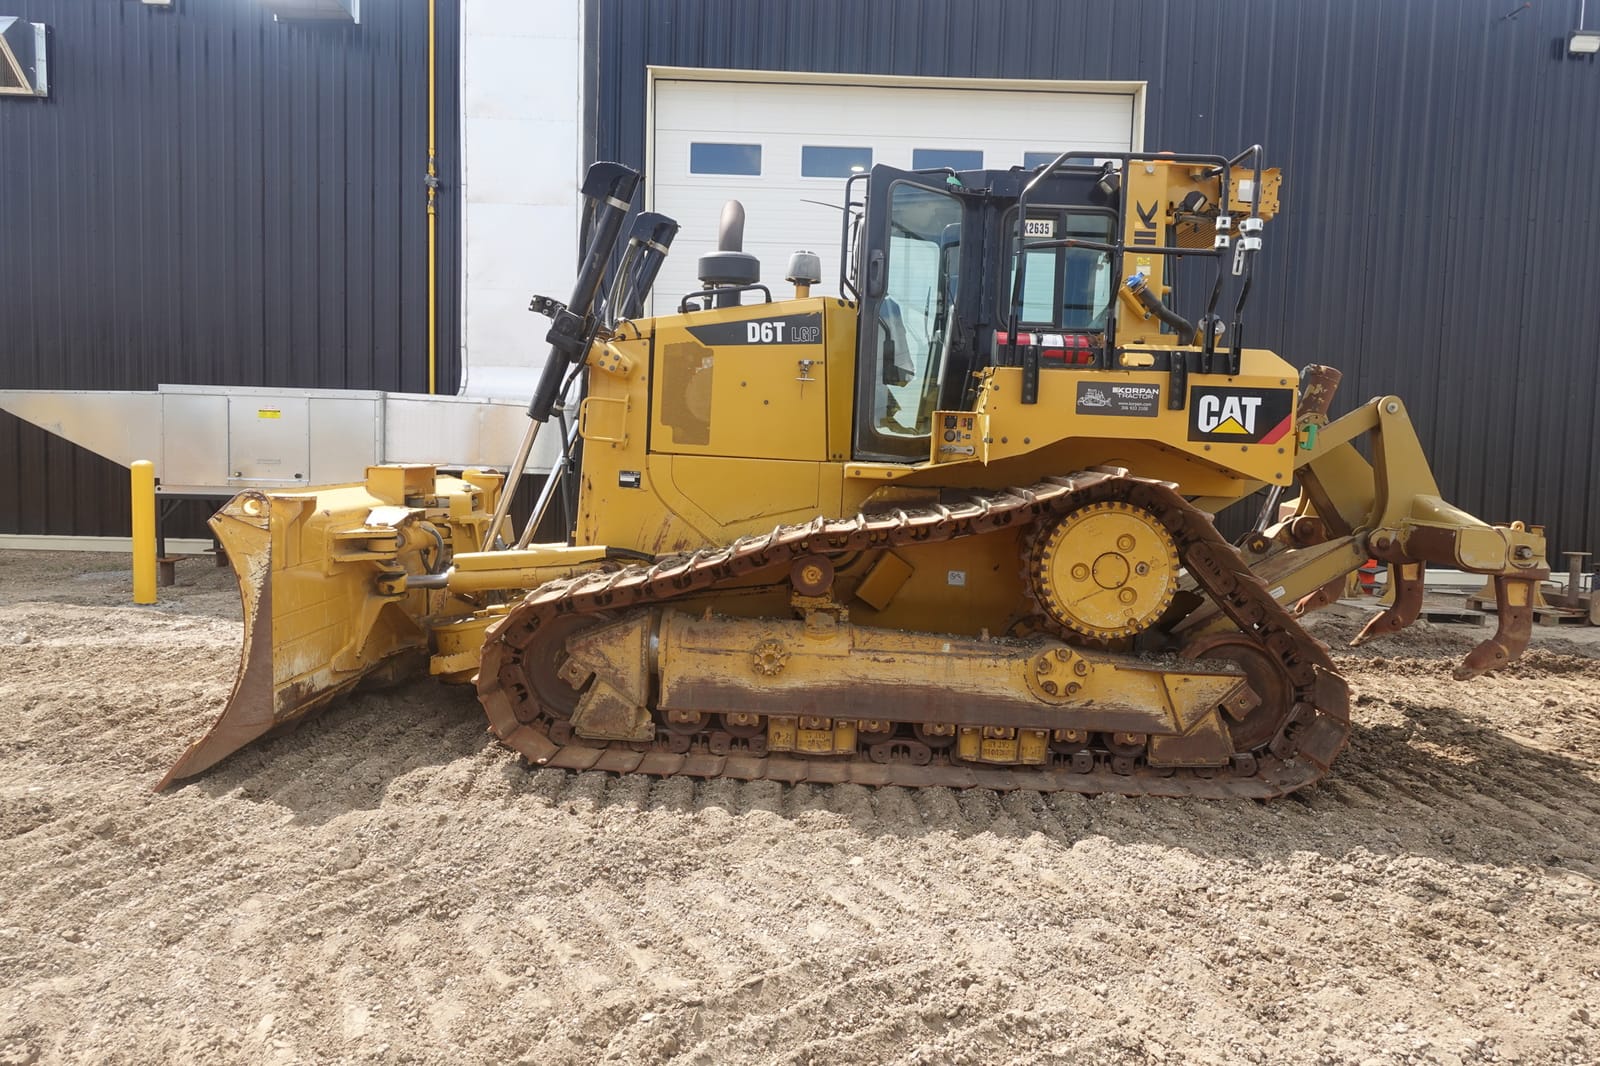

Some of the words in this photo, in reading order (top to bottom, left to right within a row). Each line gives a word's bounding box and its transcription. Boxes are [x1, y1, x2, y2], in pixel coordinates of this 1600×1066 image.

[746, 321, 786, 343] D6T
[791, 326, 820, 342] LGP
[1118, 386, 1160, 395] KORPAN
[1118, 392, 1154, 400] TRACTOR
[1198, 394, 1262, 435] CAT
